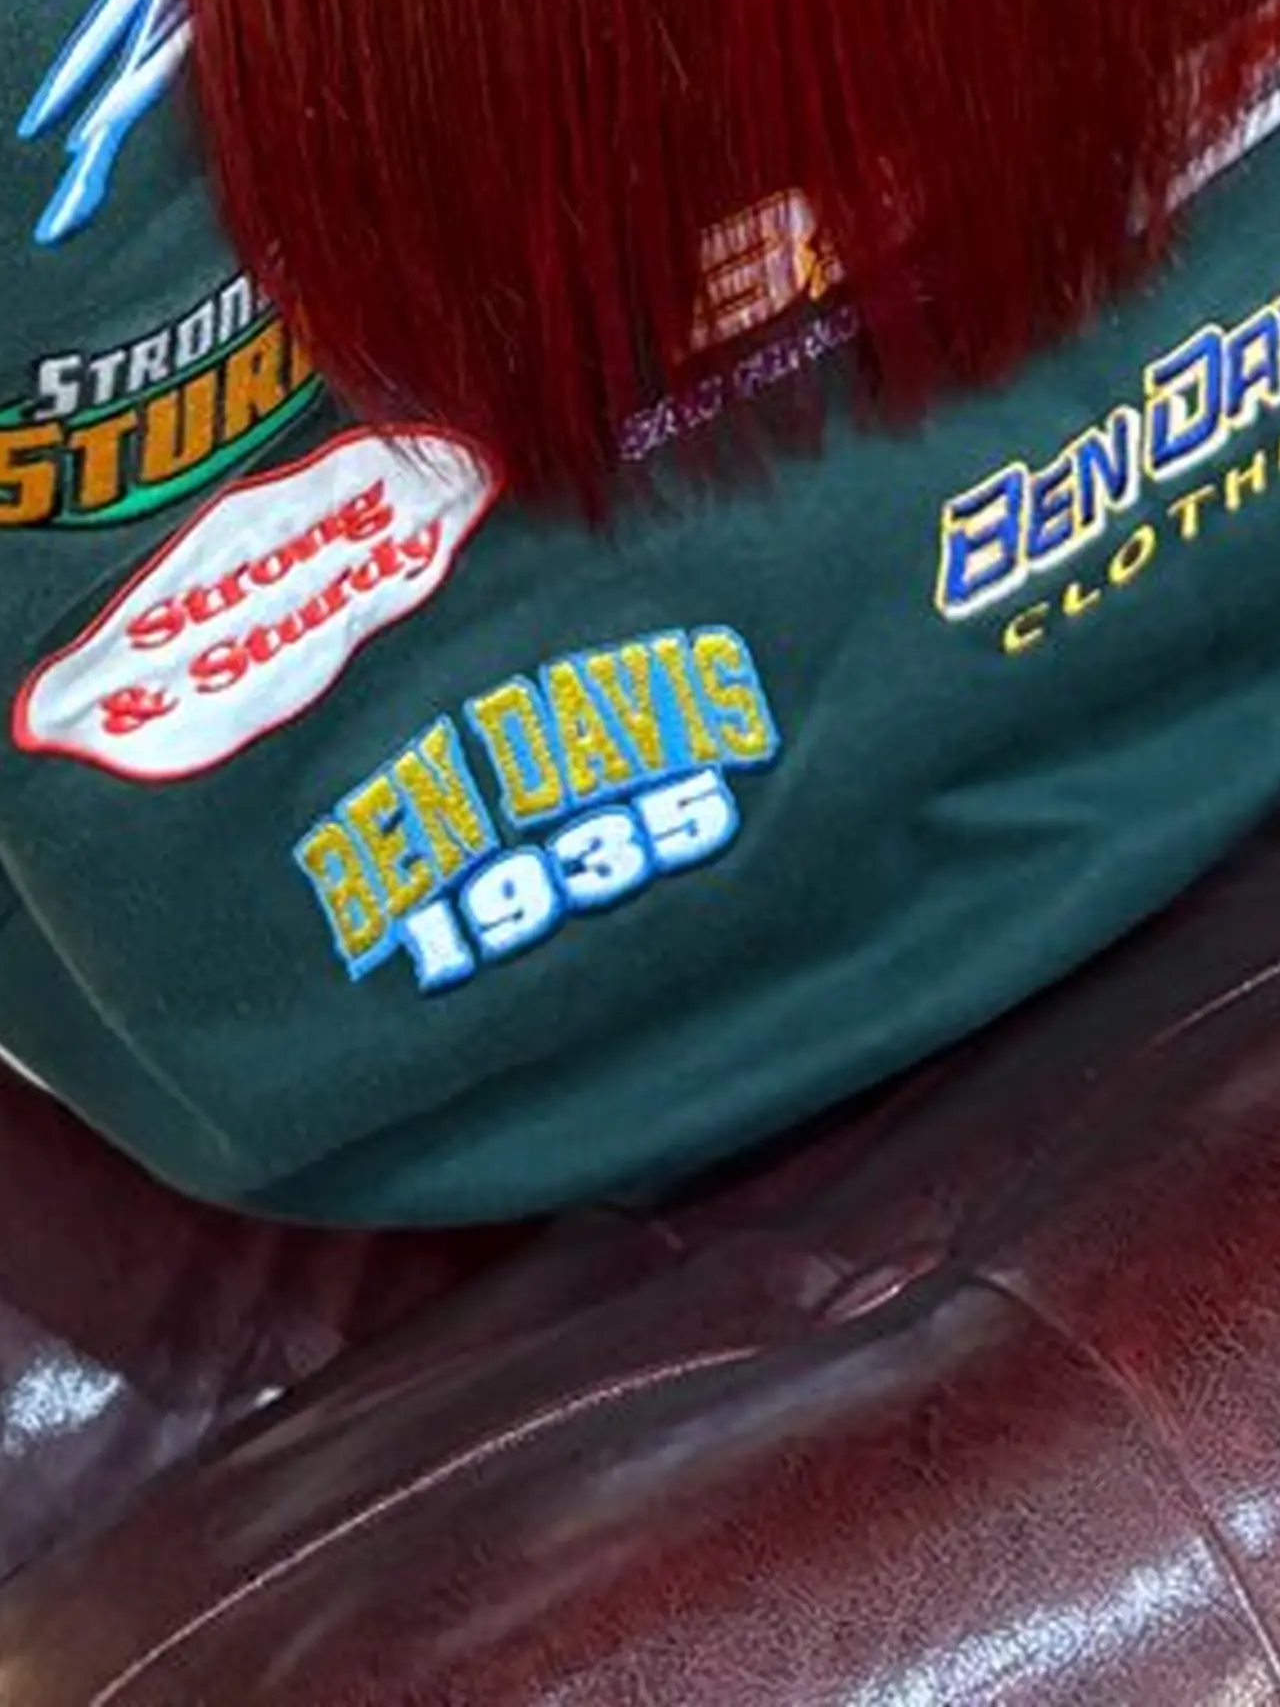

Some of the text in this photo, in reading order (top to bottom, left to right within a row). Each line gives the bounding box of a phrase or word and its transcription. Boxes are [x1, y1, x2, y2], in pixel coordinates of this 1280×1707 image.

[34, 273, 270, 419] STRON
[125, 480, 393, 649] Strong
[937, 407, 1140, 620] BEN
[99, 517, 441, 734] & Sturdy
[296, 628, 776, 969] BEN DAVIS
[402, 768, 737, 985] 1935
